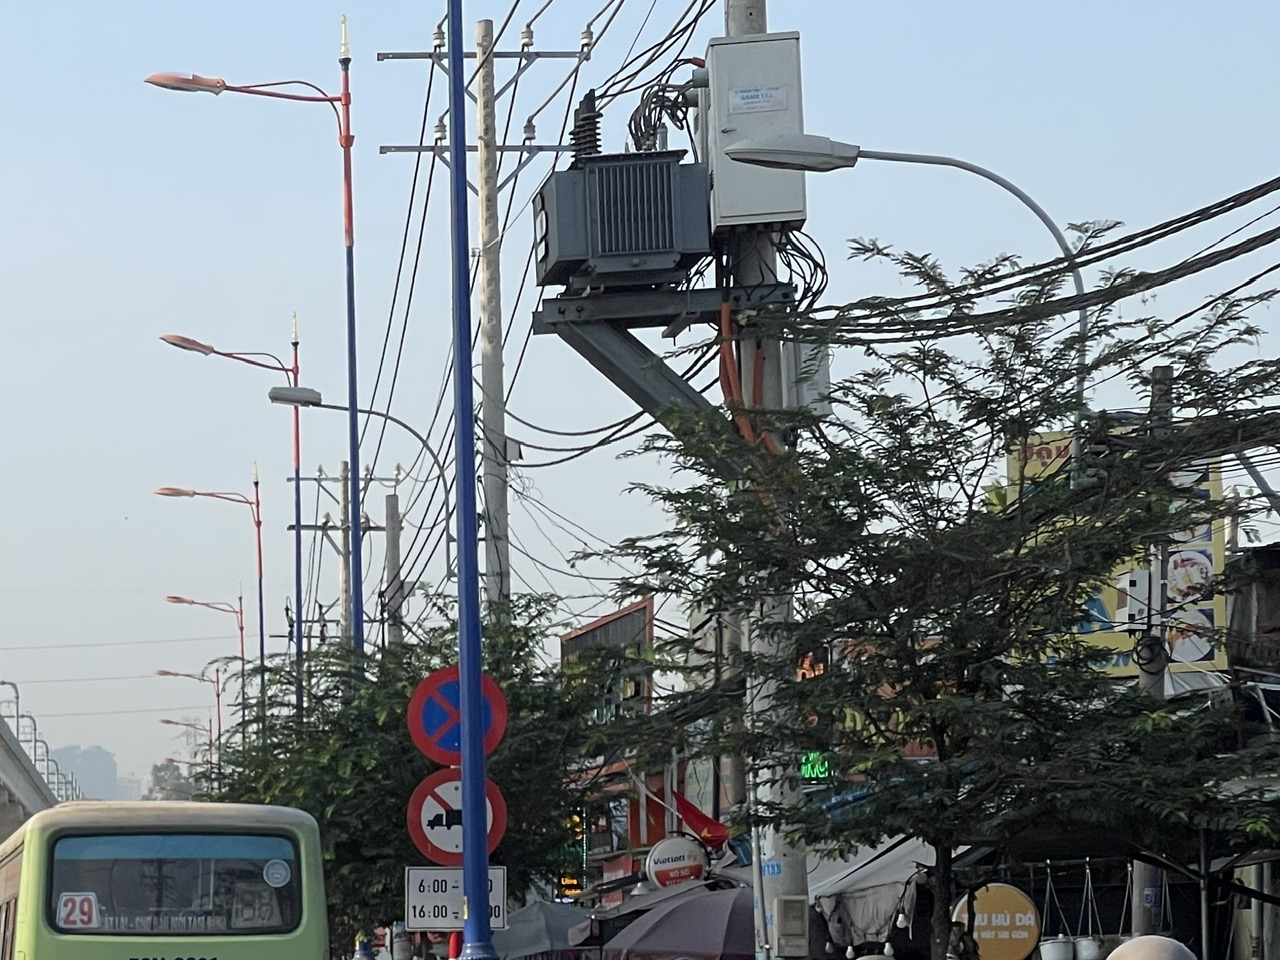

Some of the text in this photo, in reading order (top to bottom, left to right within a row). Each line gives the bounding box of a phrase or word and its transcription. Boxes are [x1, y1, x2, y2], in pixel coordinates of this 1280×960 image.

[418, 879, 447, 893] 6:00
[62, 896, 94, 926] 29
[411, 904, 447, 918] 16:00
